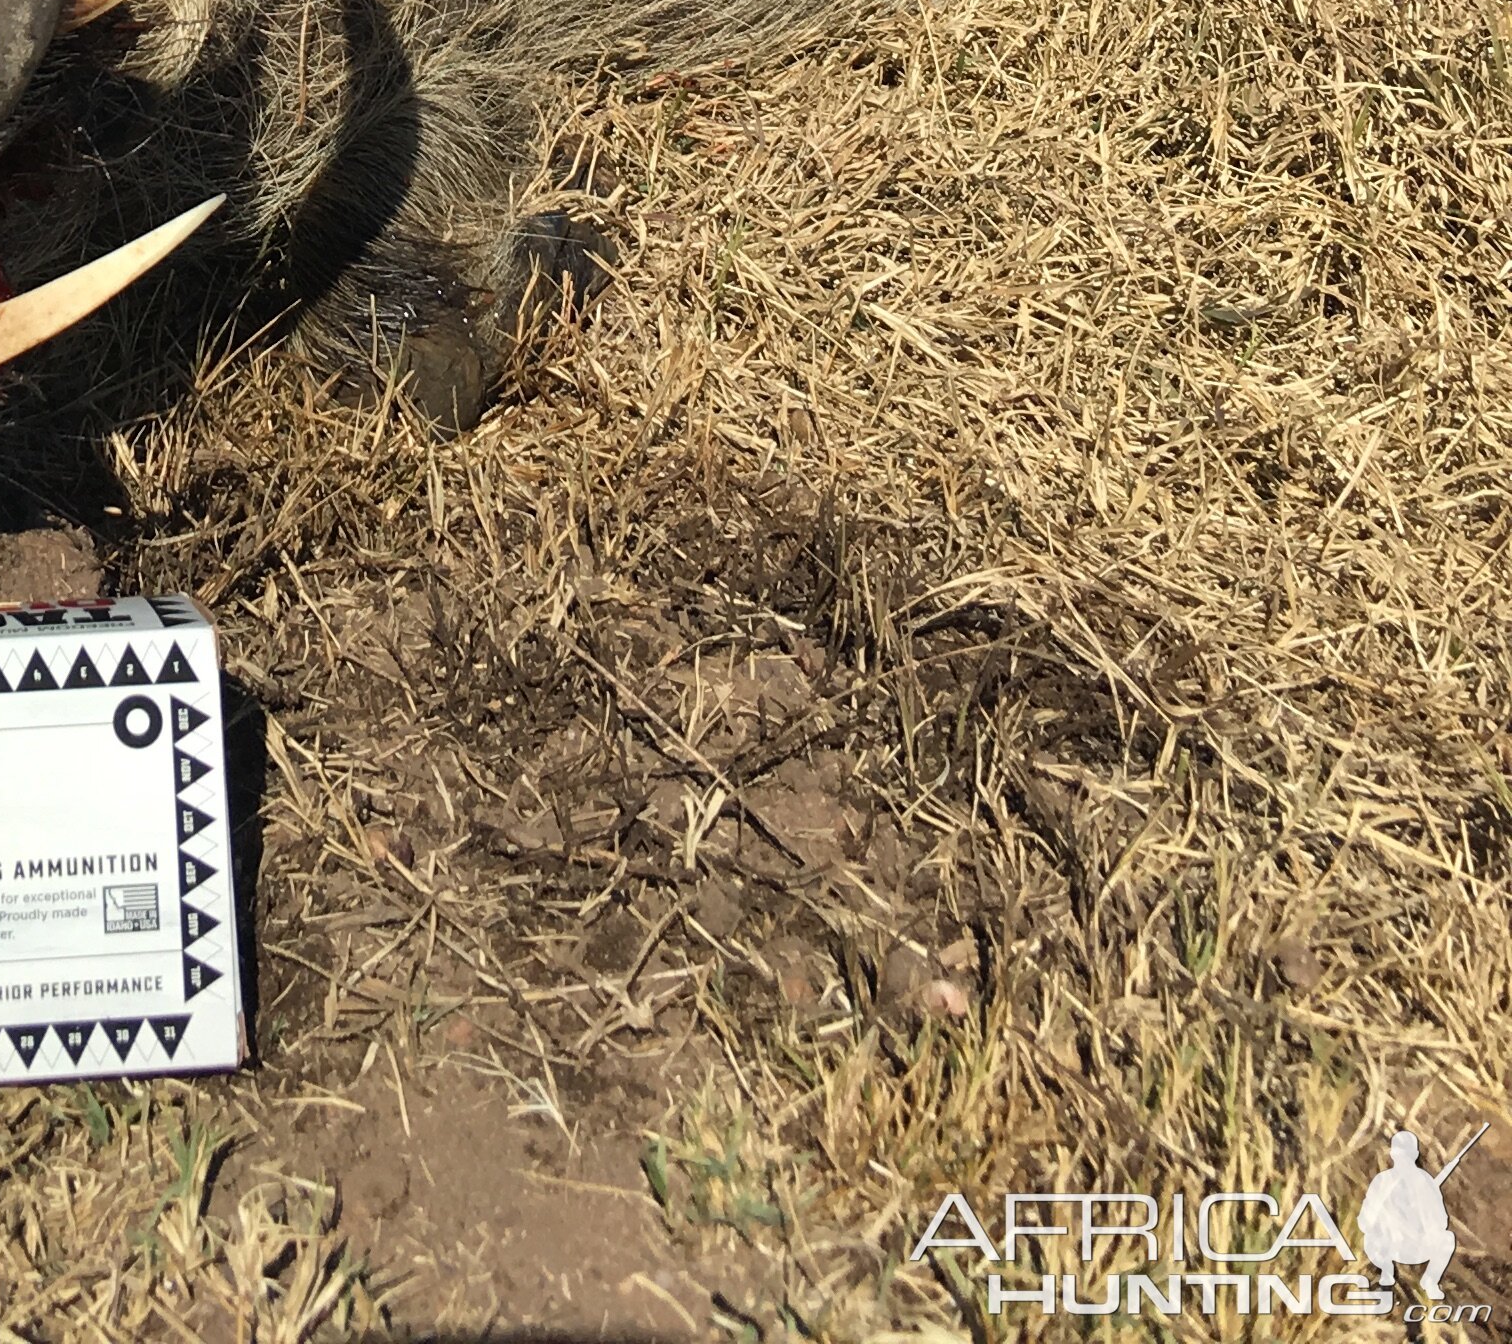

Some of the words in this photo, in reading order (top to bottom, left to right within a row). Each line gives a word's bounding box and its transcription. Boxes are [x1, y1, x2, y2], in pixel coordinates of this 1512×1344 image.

[33, 668, 42, 681] 4
[80, 666, 88, 679] 3
[126, 663, 134, 677] 2
[172, 660, 180, 674] 1
[177, 707, 190, 731] DEC
[180, 757, 192, 783] NOV
[182, 809, 195, 833] OCT
[13, 852, 158, 880] AMMUNITION
[185, 861, 197, 885] SEP
[0, 892, 20, 905] for
[22, 887, 97, 905] exceptional
[52, 906, 88, 920] made
[106, 919, 133, 931] IDAHO
[139, 918, 157, 930] USA
[187, 912, 199, 937] AUG
[190, 965, 202, 989] JUL
[40, 975, 164, 998] PERFORMANCE
[68, 1031, 82, 1047] 29
[115, 1028, 130, 1043] 30
[163, 1025, 177, 1041] 31
[20, 1035, 35, 1050] 28
